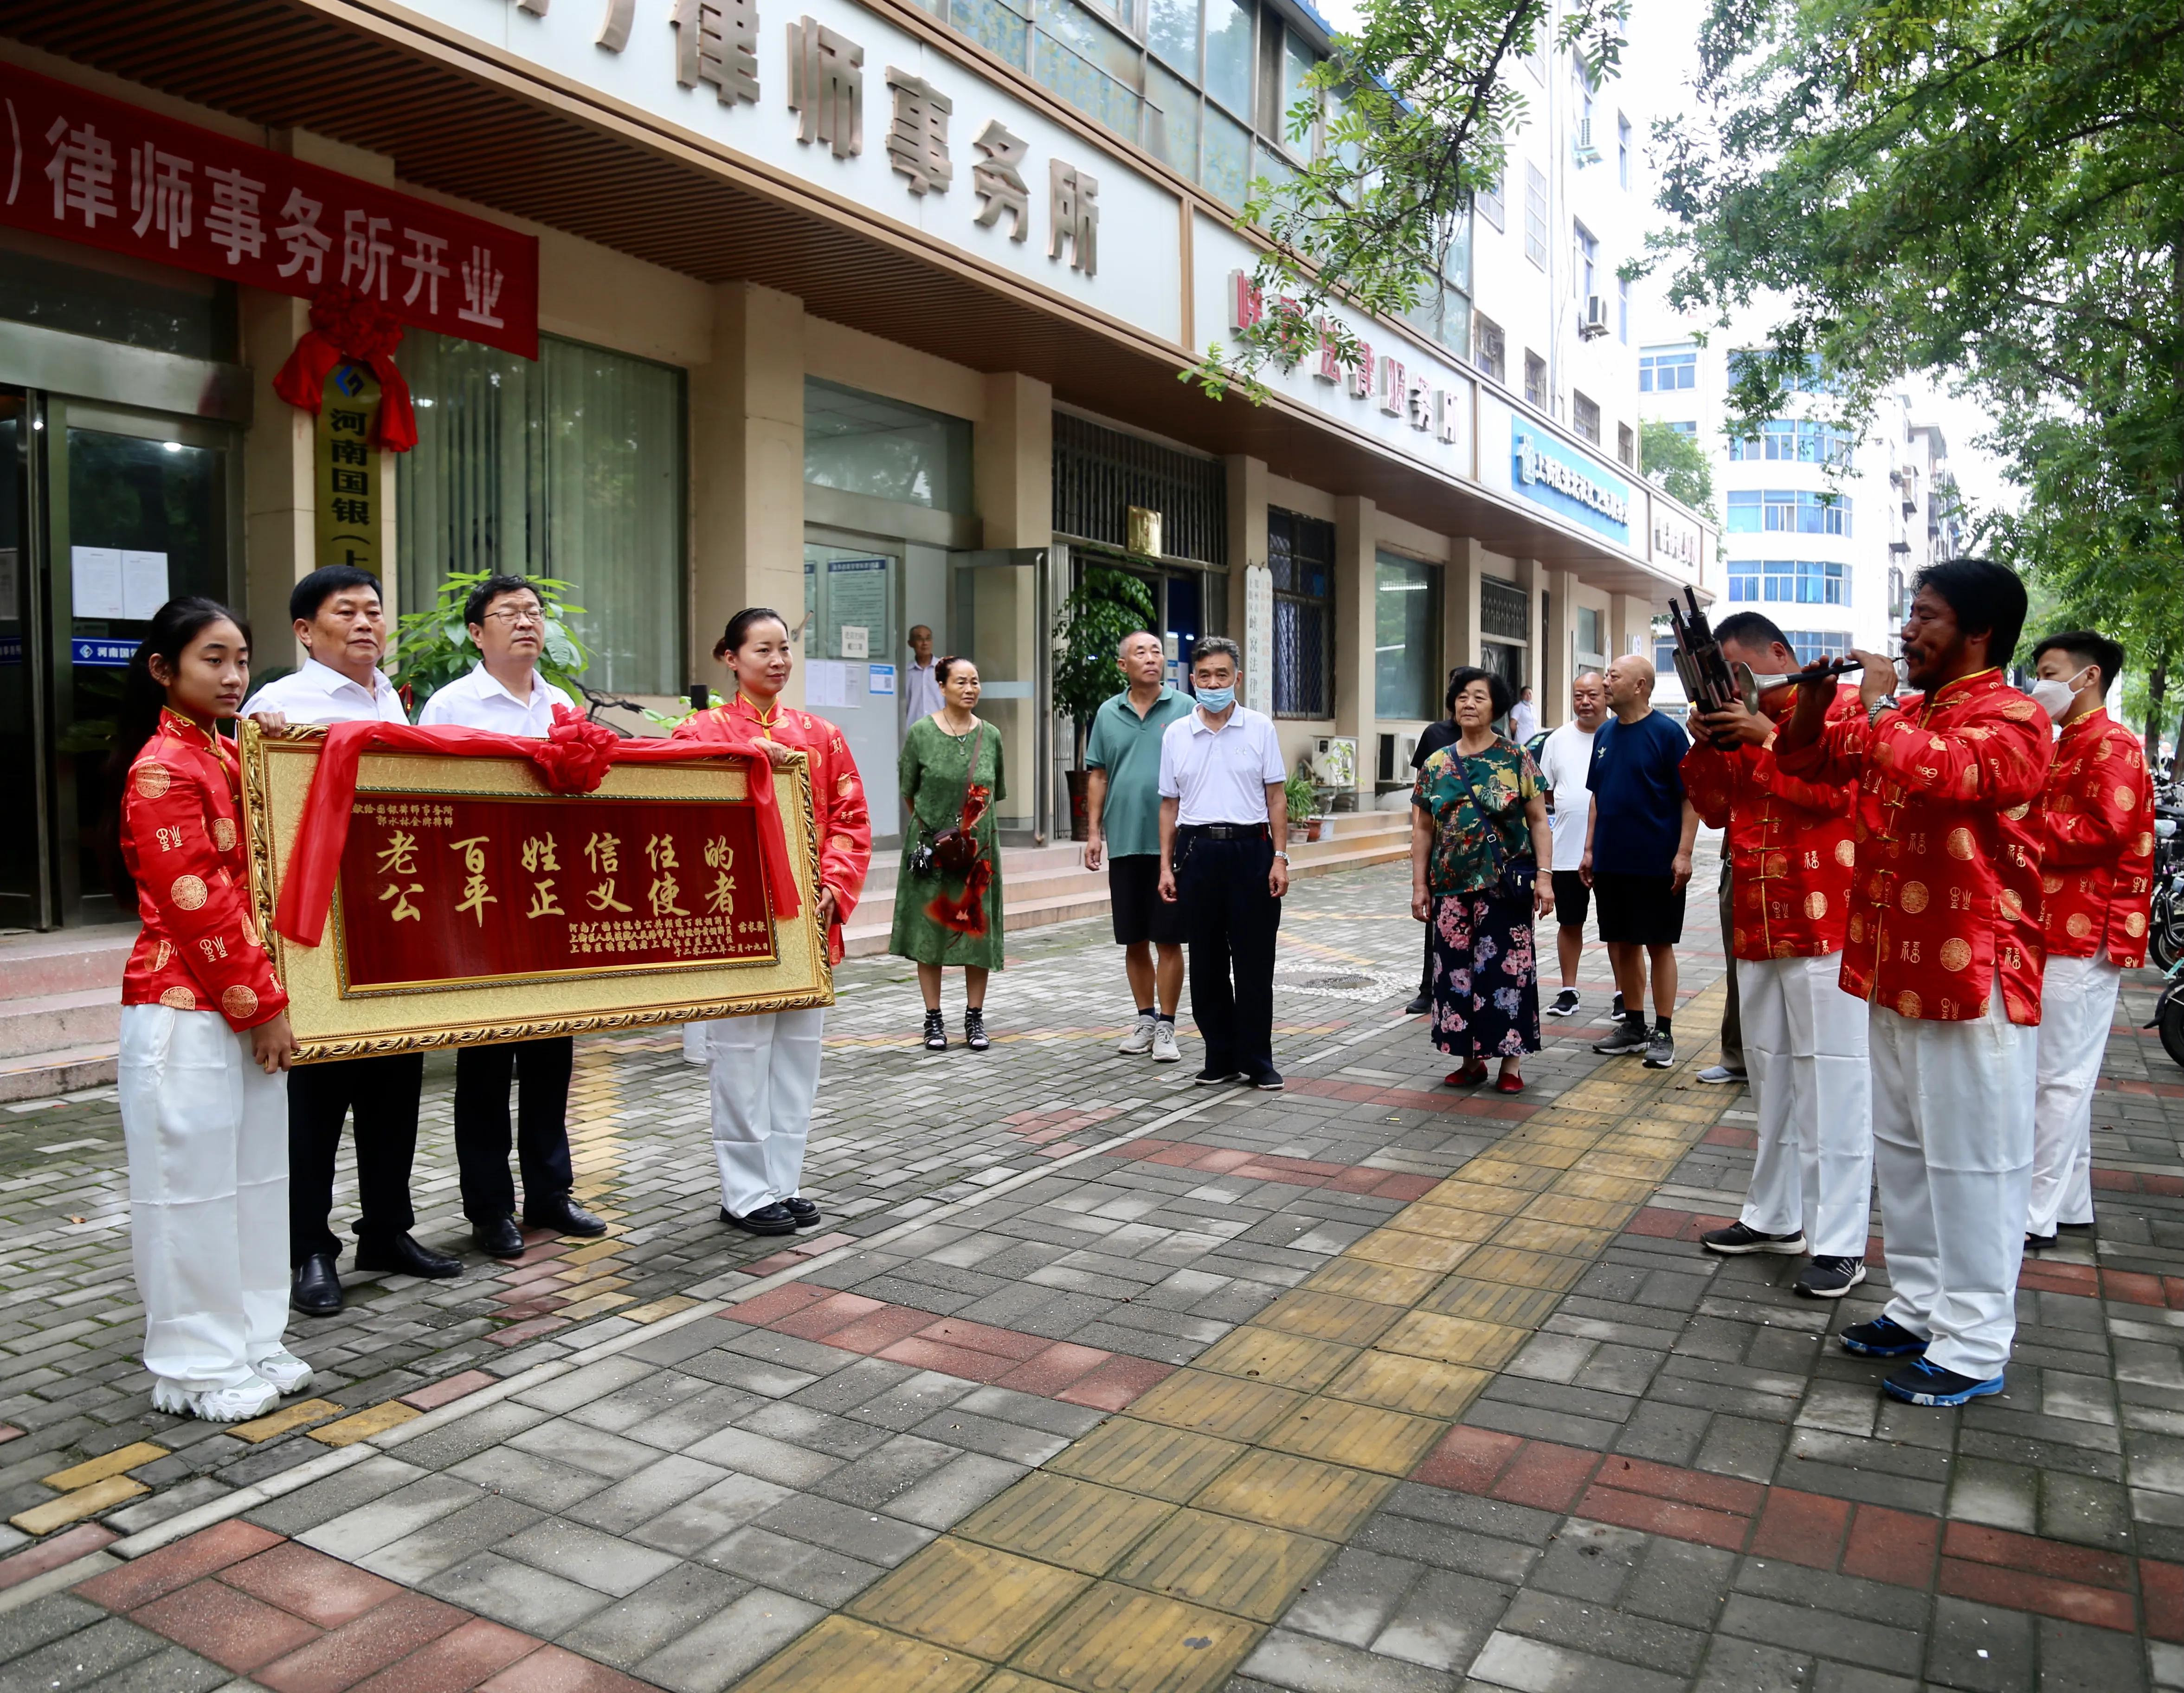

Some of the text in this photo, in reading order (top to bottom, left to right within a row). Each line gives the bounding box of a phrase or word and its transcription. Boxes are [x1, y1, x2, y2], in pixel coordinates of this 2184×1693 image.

[516, 0, 1100, 277] 律师事务所
[376, 830, 734, 875] 老百姓信任的
[378, 871, 737, 928] 公平正义使者
